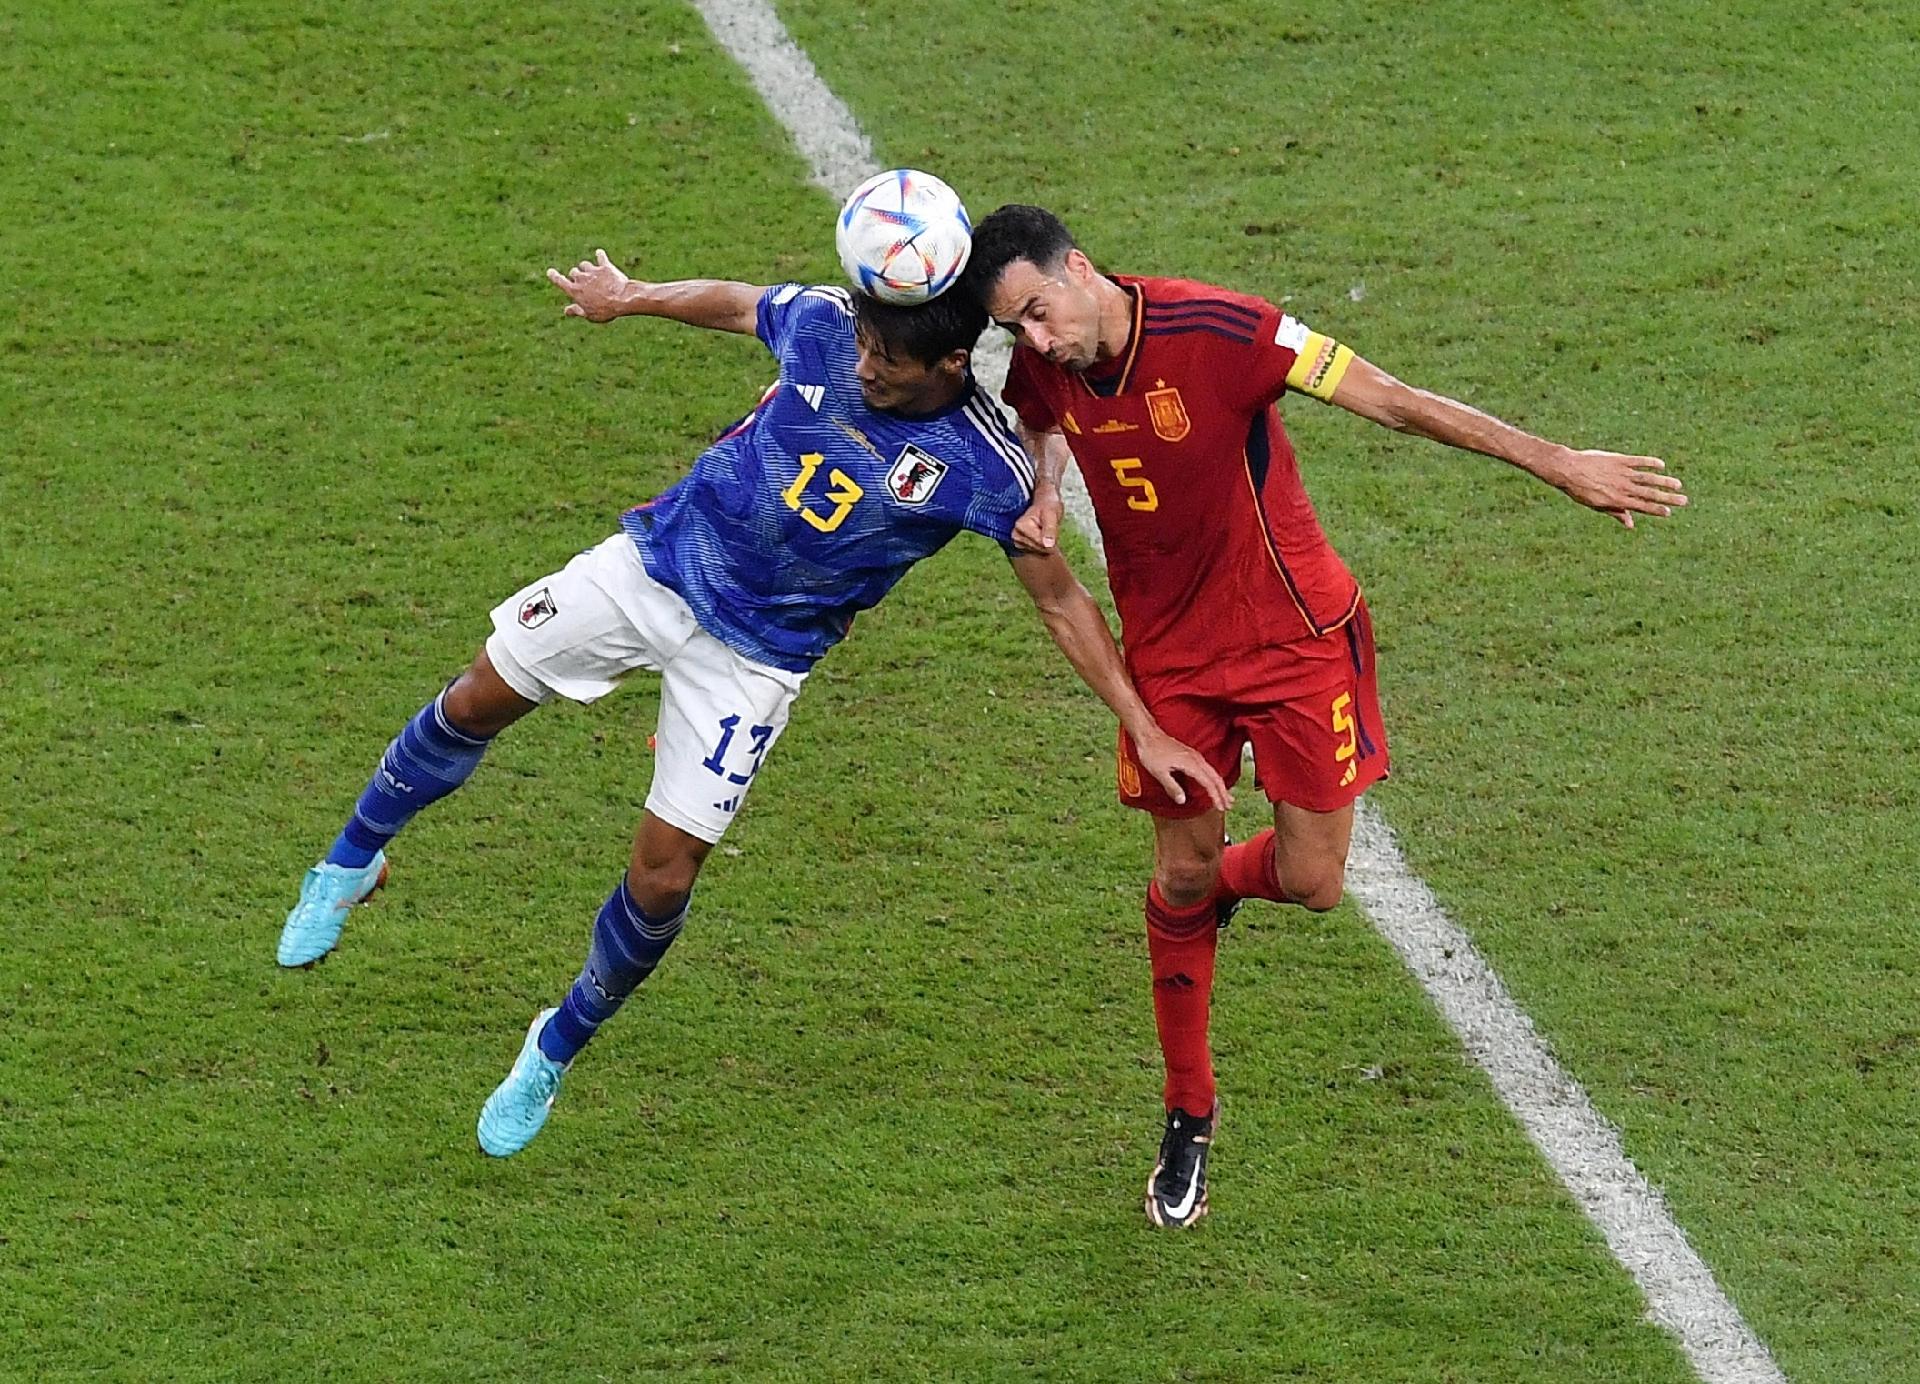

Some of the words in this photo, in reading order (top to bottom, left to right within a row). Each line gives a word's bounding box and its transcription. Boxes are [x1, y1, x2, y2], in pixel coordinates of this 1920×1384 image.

[781, 452, 864, 532] 13
[1110, 457, 1159, 512] 5
[702, 713, 774, 786] 13
[1331, 690, 1358, 762] 5
